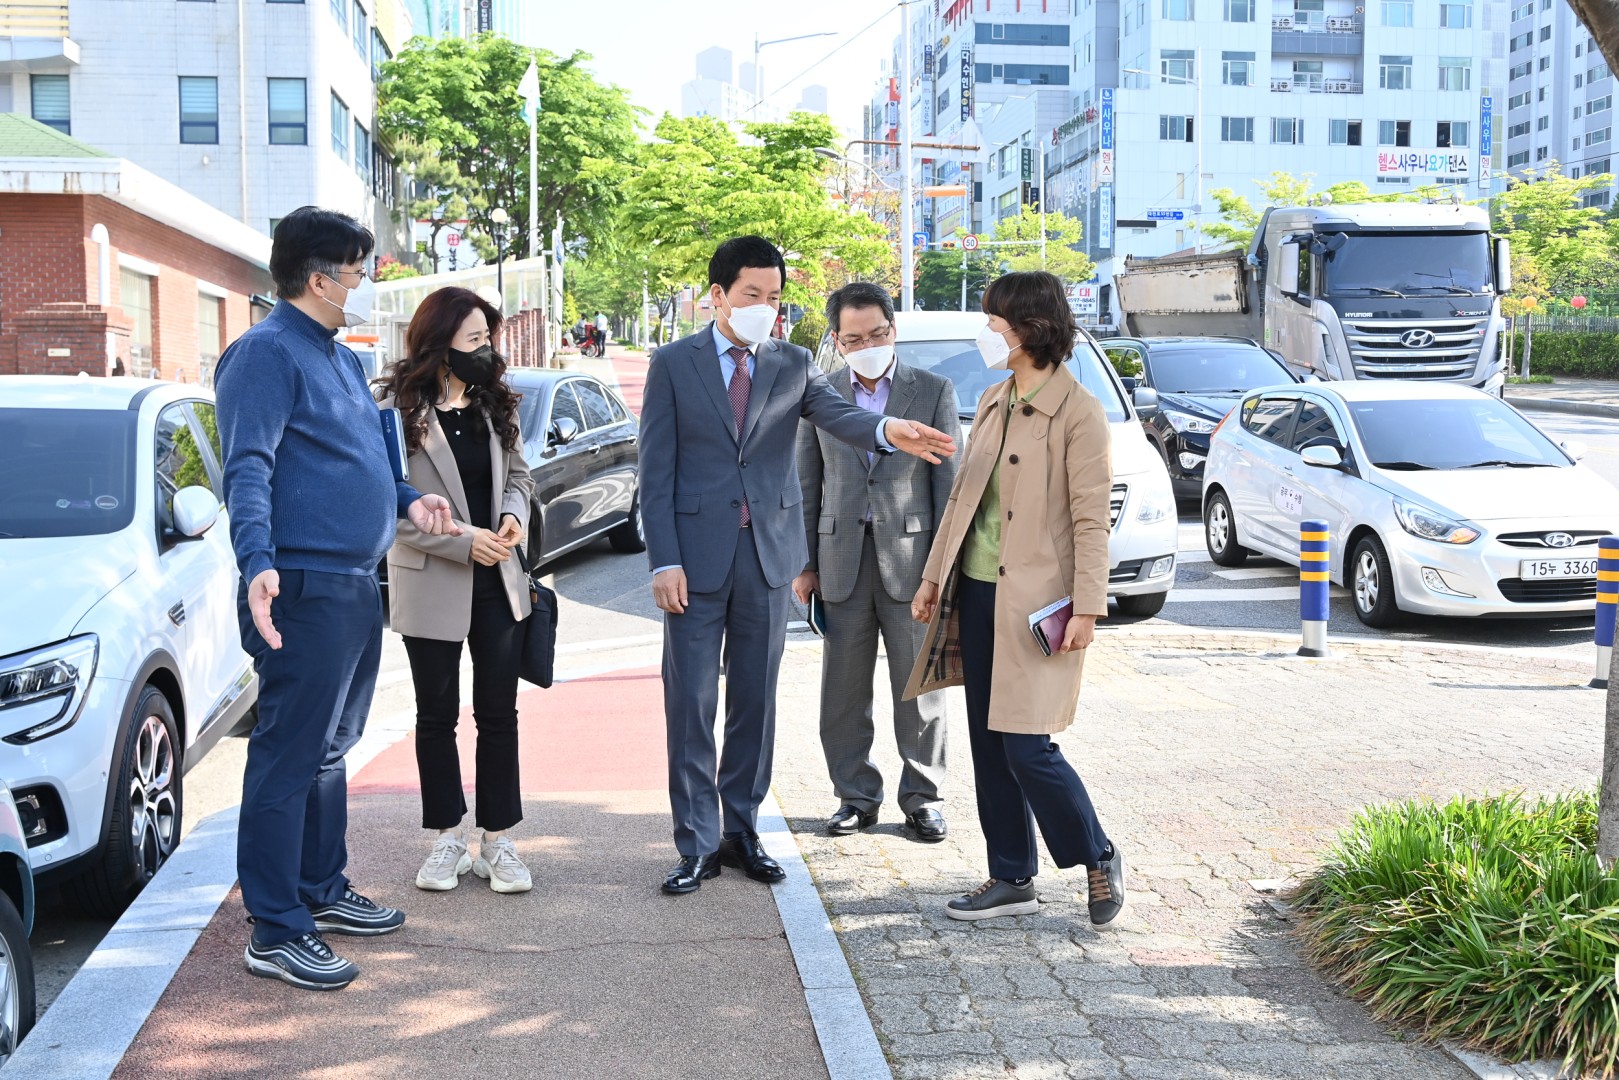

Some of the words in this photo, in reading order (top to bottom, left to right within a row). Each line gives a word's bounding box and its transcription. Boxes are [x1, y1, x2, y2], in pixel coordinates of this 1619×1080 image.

[1102, 107, 1112, 148] 사우나
[1482, 116, 1491, 154] 사우나
[1102, 152, 1111, 176] 헬스
[1378, 153, 1468, 173] 헬스사우나요가댄스
[966, 238, 975, 247] 50
[1531, 562, 1557, 576] 15누
[1563, 560, 1598, 575] 3360
